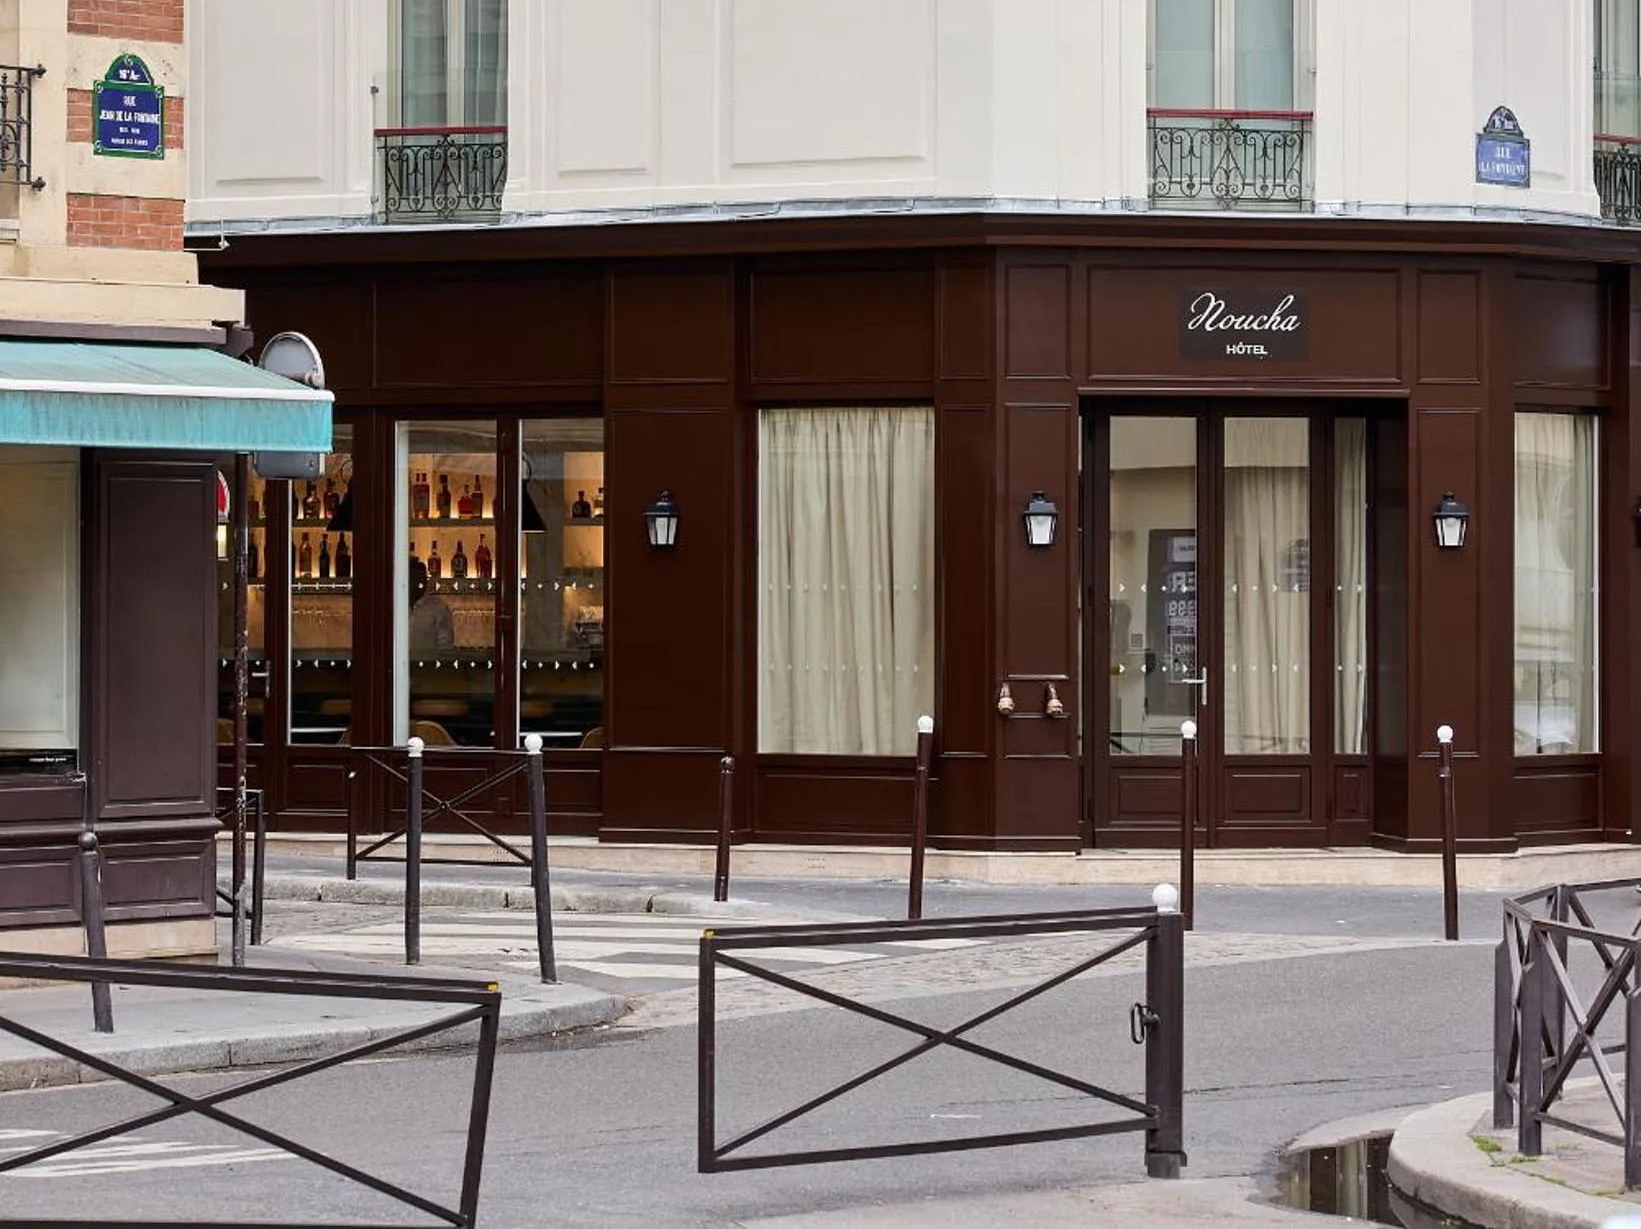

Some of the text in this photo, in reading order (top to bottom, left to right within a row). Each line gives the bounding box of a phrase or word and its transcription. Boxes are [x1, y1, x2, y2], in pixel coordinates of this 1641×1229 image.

[124, 112, 133, 122] LA
[1187, 291, 1301, 332] Noucha
[1226, 341, 1268, 355] HÔTEL
